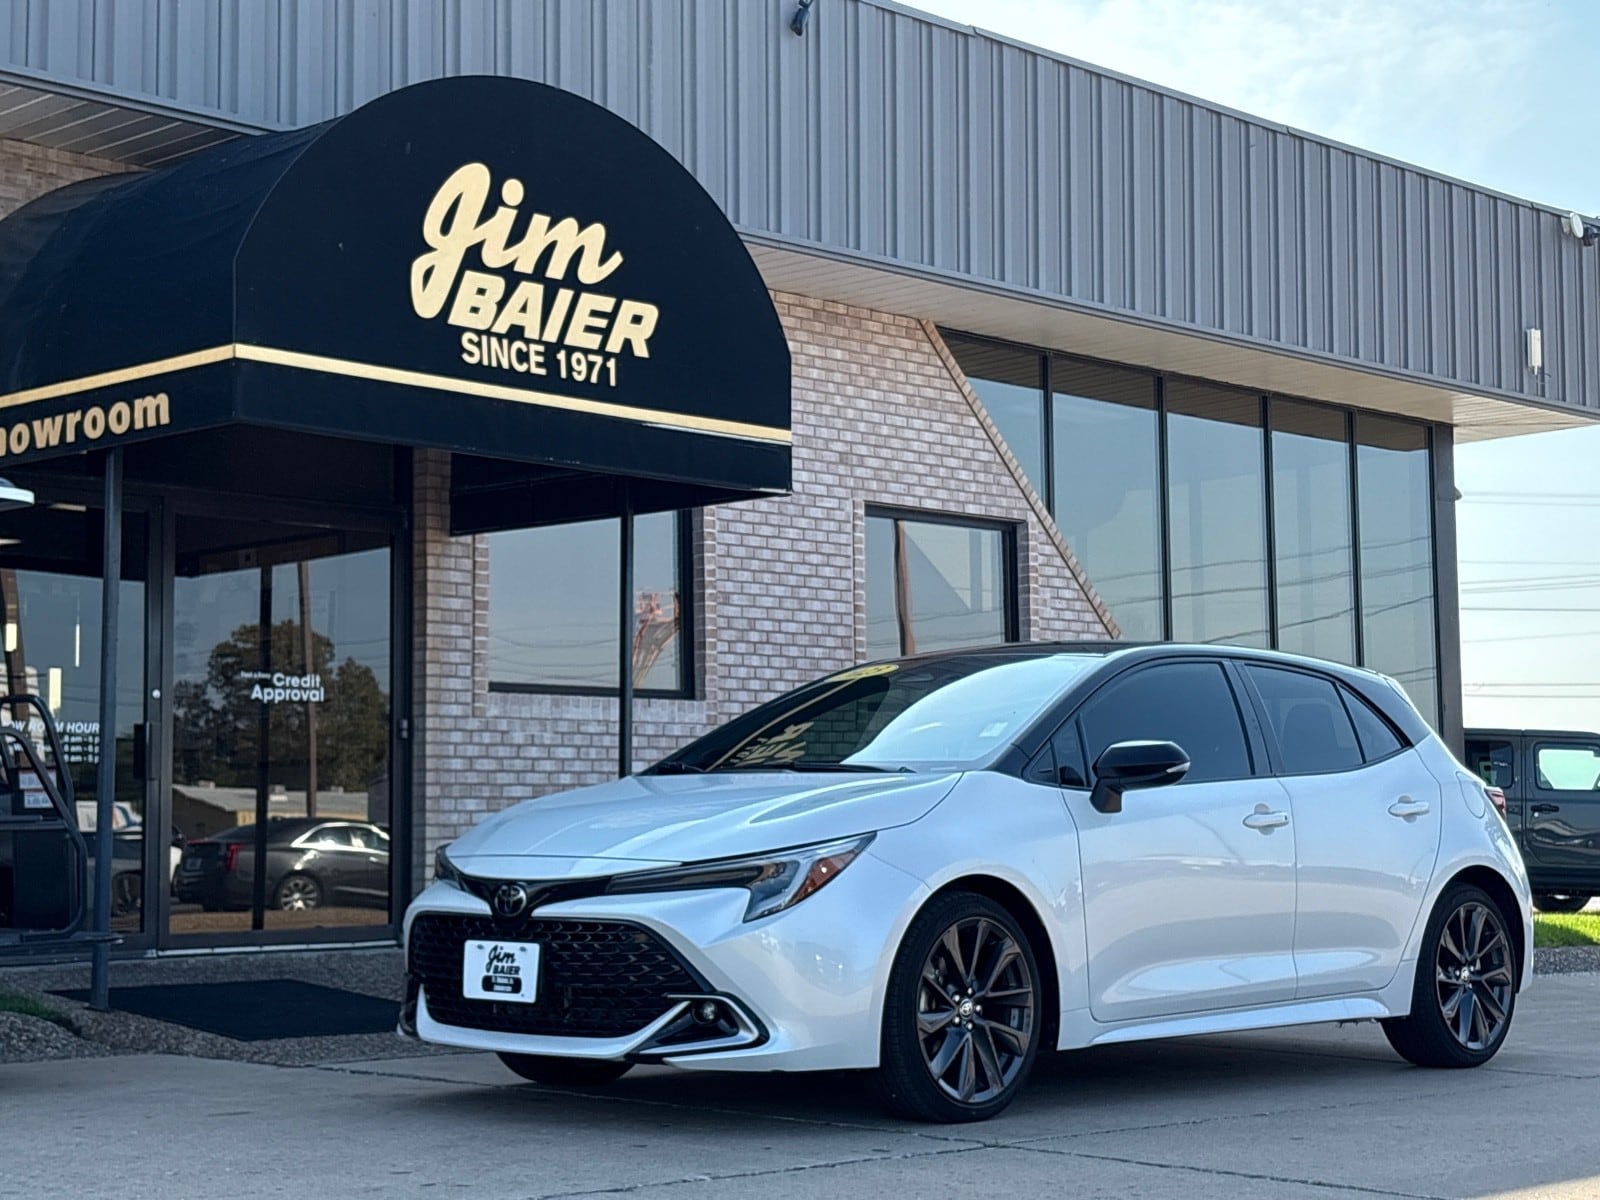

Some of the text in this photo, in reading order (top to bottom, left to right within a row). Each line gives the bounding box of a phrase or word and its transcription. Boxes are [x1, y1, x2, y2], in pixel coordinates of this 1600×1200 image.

[410, 162, 624, 319] Jim
[447, 269, 660, 358] BAIER
[460, 332, 617, 387] SINCE 1971
[272, 672, 321, 688] Credit
[250, 684, 325, 704] Approval
[28, 720, 64, 733] ROM
[485, 944, 516, 973] Jim
[492, 965, 521, 975] BAIER
